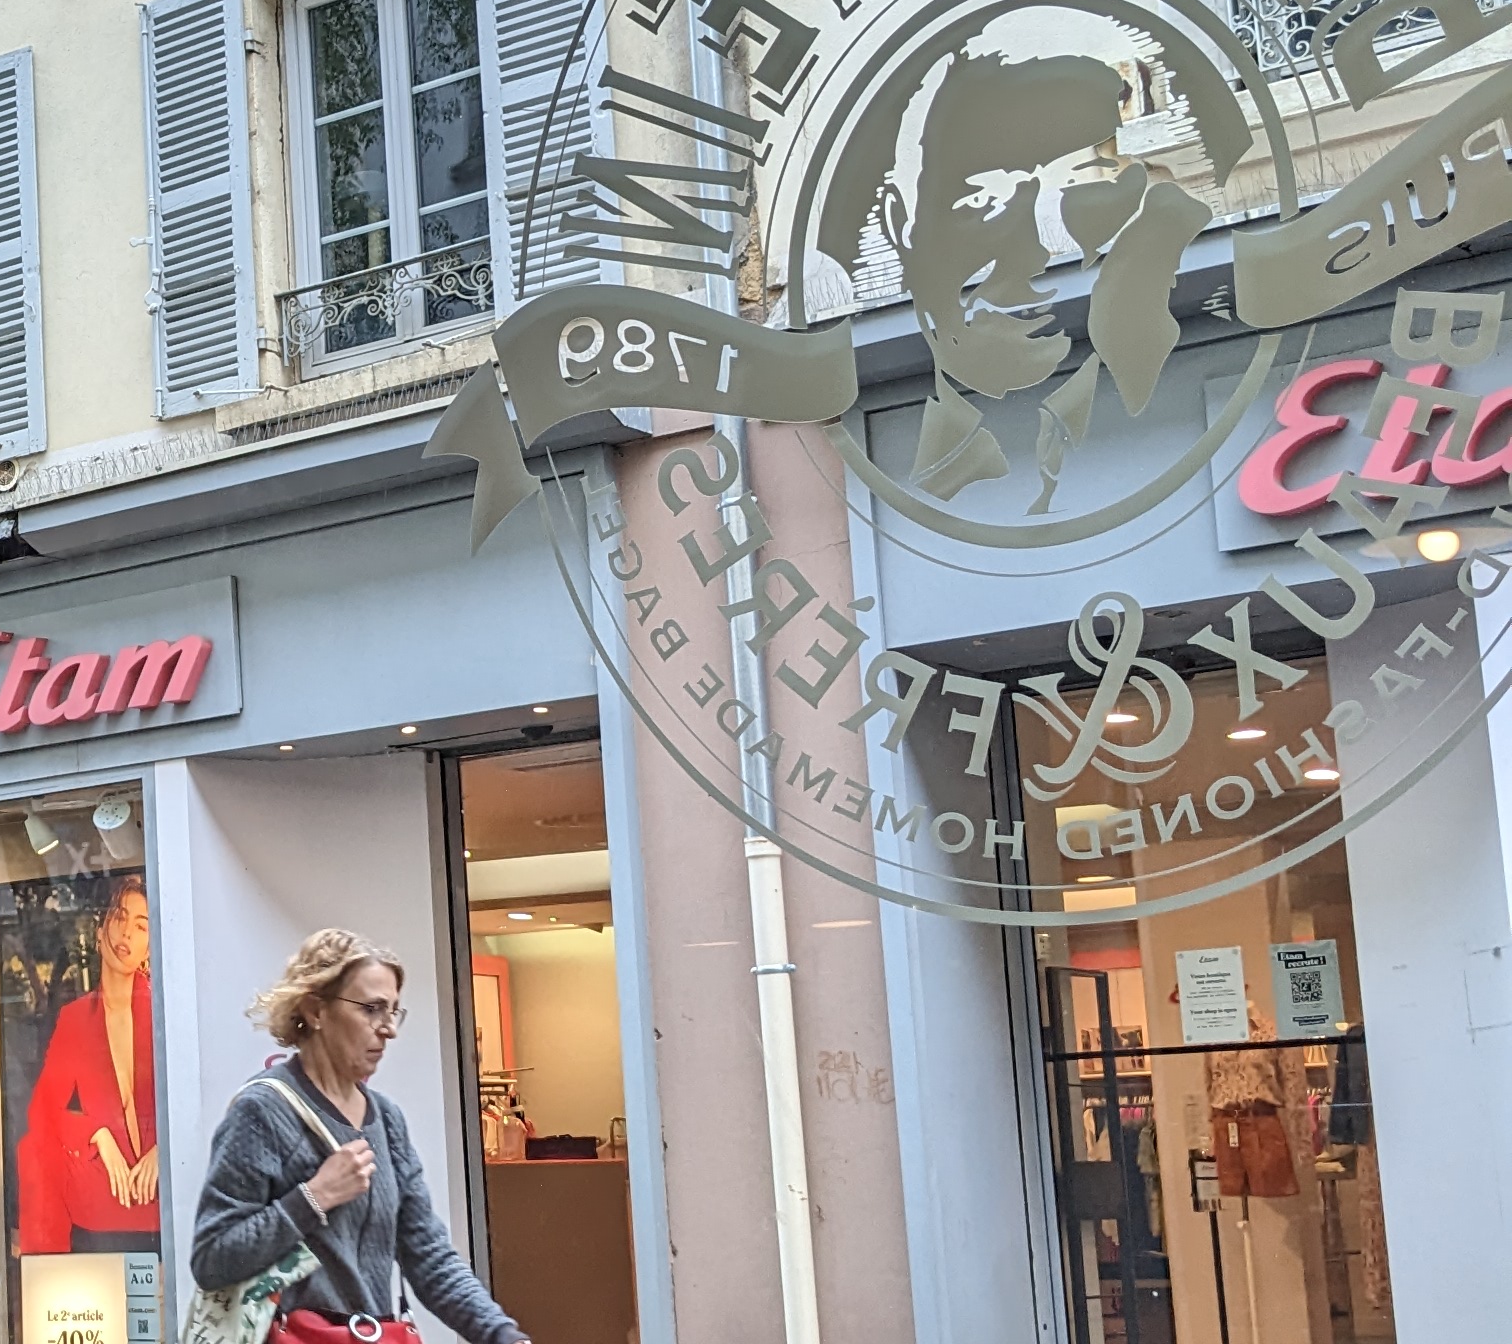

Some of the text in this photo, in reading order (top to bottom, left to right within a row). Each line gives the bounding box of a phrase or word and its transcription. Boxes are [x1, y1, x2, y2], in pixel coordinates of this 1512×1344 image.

[1280, 952, 1304, 961] Etam
[131, 1273, 139, 1284] A
[145, 1273, 154, 1284] G
[47, 1311, 59, 1322] Le
[72, 1309, 104, 1322] article
